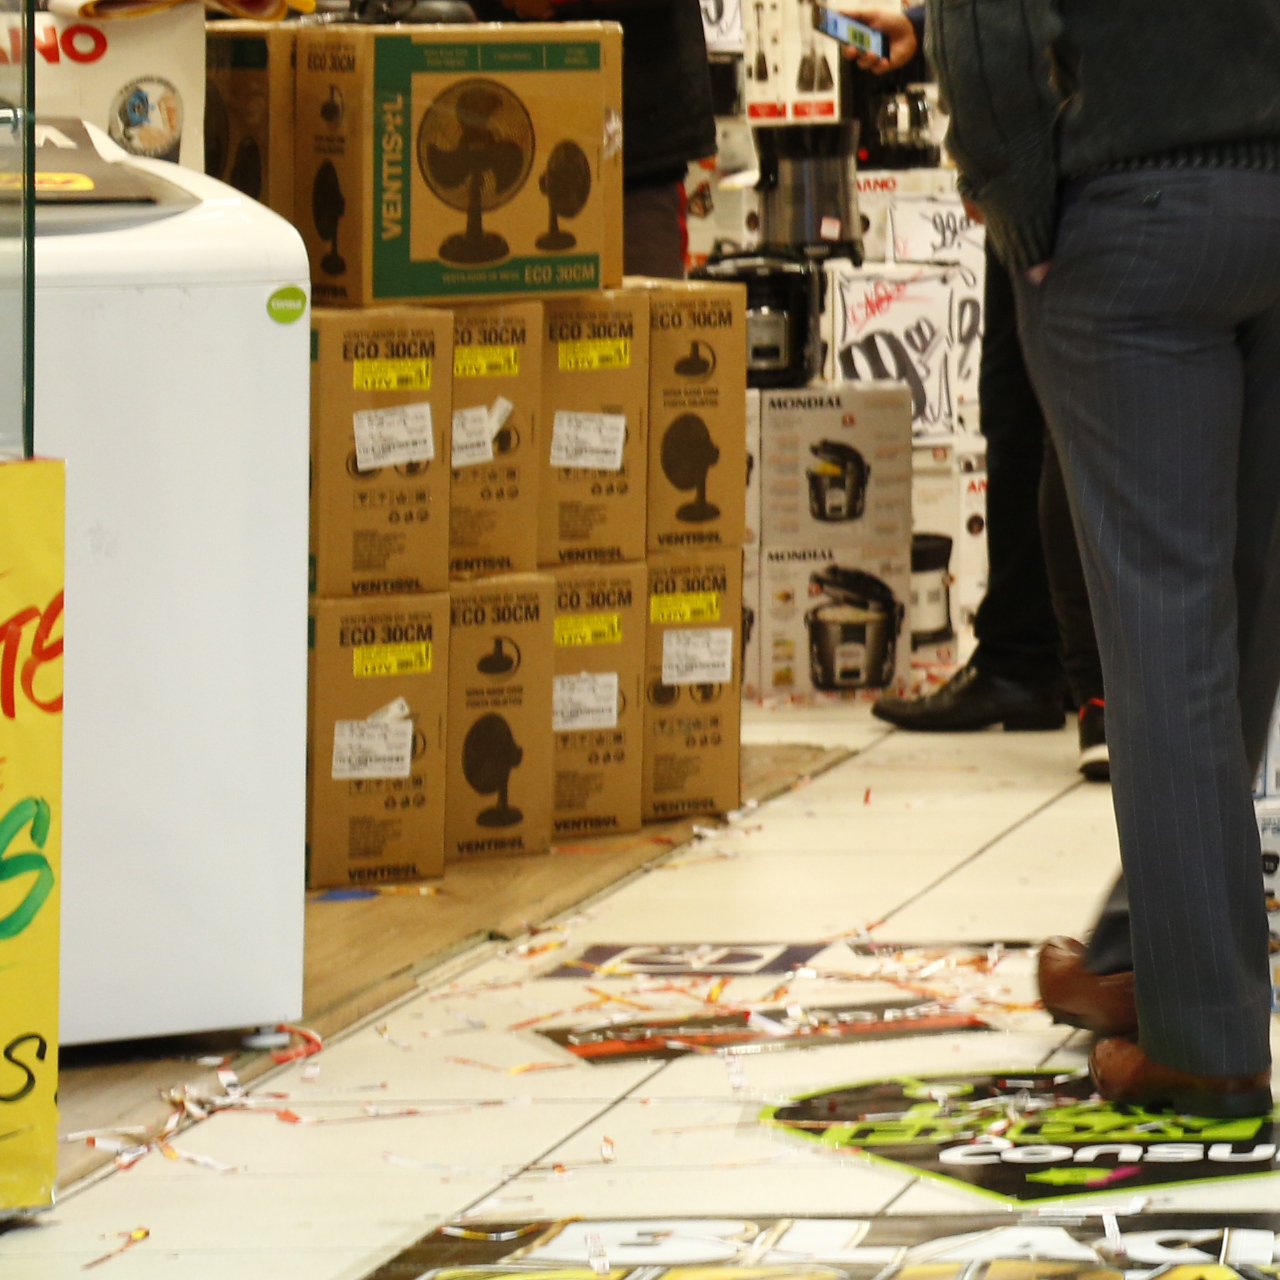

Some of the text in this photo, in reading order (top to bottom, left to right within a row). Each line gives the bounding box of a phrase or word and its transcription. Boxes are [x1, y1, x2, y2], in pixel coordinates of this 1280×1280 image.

[650, 309, 732, 330] ECO 30CM
[478, 326, 526, 345] 30CM
[549, 321, 633, 342] ECO 30CM
[343, 340, 435, 361] ECO 30CM
[768, 397, 843, 413] MONDIAL
[558, 546, 624, 563] VENTISOL
[767, 549, 835, 564] MONDIAL
[351, 577, 423, 594] VENTISOL
[654, 573, 727, 594] CO 30CM
[558, 589, 632, 609] CO 30CM
[451, 604, 540, 629] ECO 30CM
[340, 623, 433, 647] ECO 30CM
[653, 796, 716, 813] VENTISOL
[554, 815, 619, 832] VENTISOL
[457, 836, 525, 853] VENTISOL
[348, 865, 418, 882] VENTISOL
